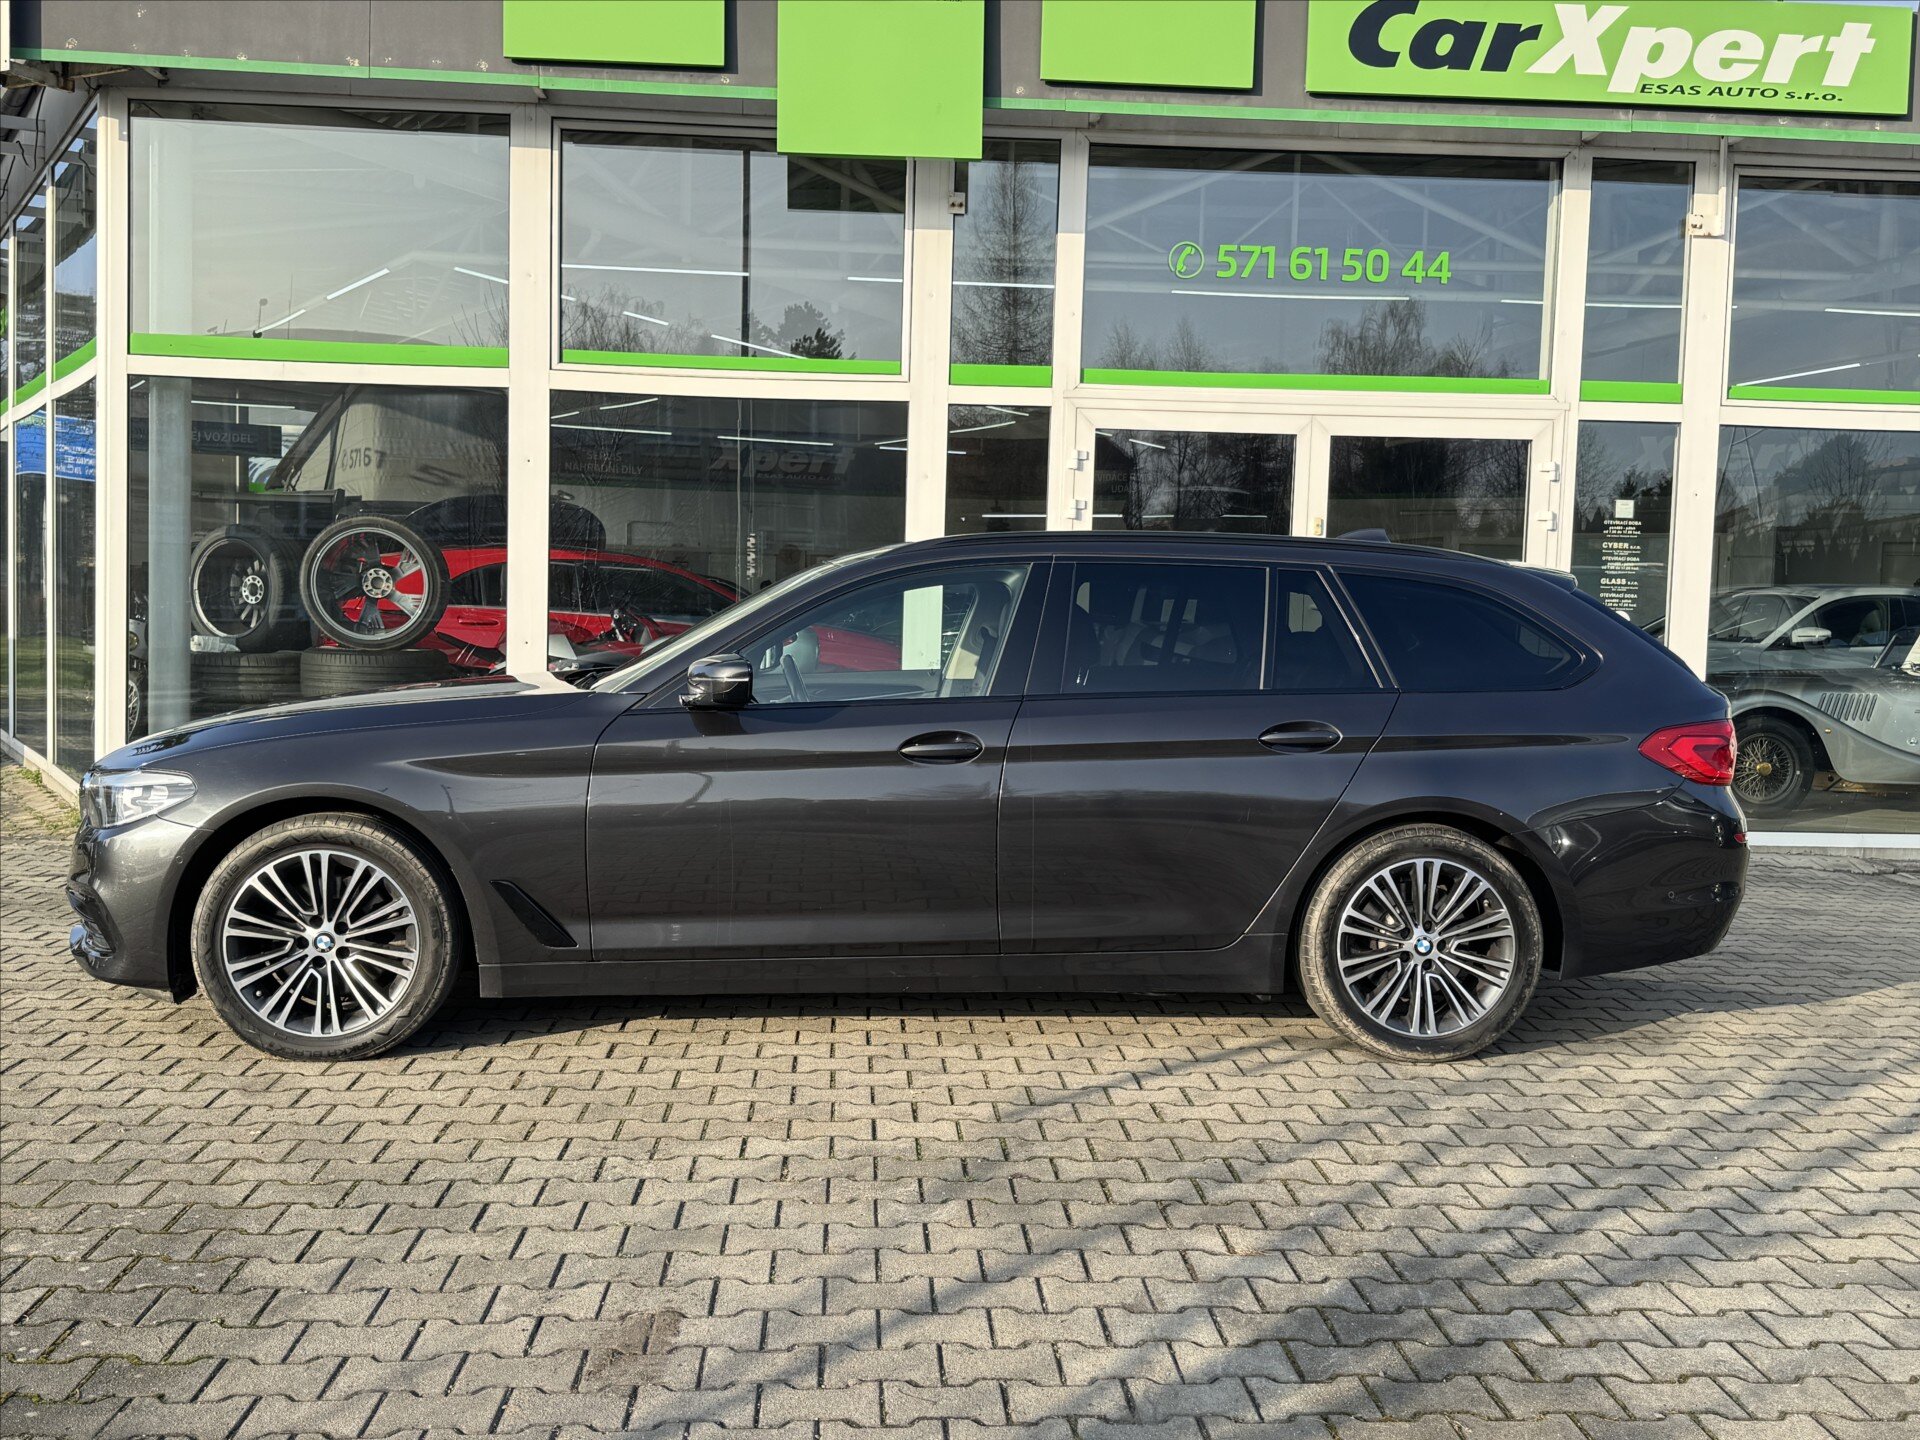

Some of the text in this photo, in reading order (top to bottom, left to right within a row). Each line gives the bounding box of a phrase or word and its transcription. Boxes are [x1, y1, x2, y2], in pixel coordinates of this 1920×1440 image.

[1348, 0, 1876, 94] CarXpert
[1640, 83, 1844, 102] ESAS AUTO s.r.o.
[1216, 244, 1452, 284] 571 61 50 44
[1602, 541, 1629, 549] CYBER
[1600, 577, 1626, 585] GLASS
